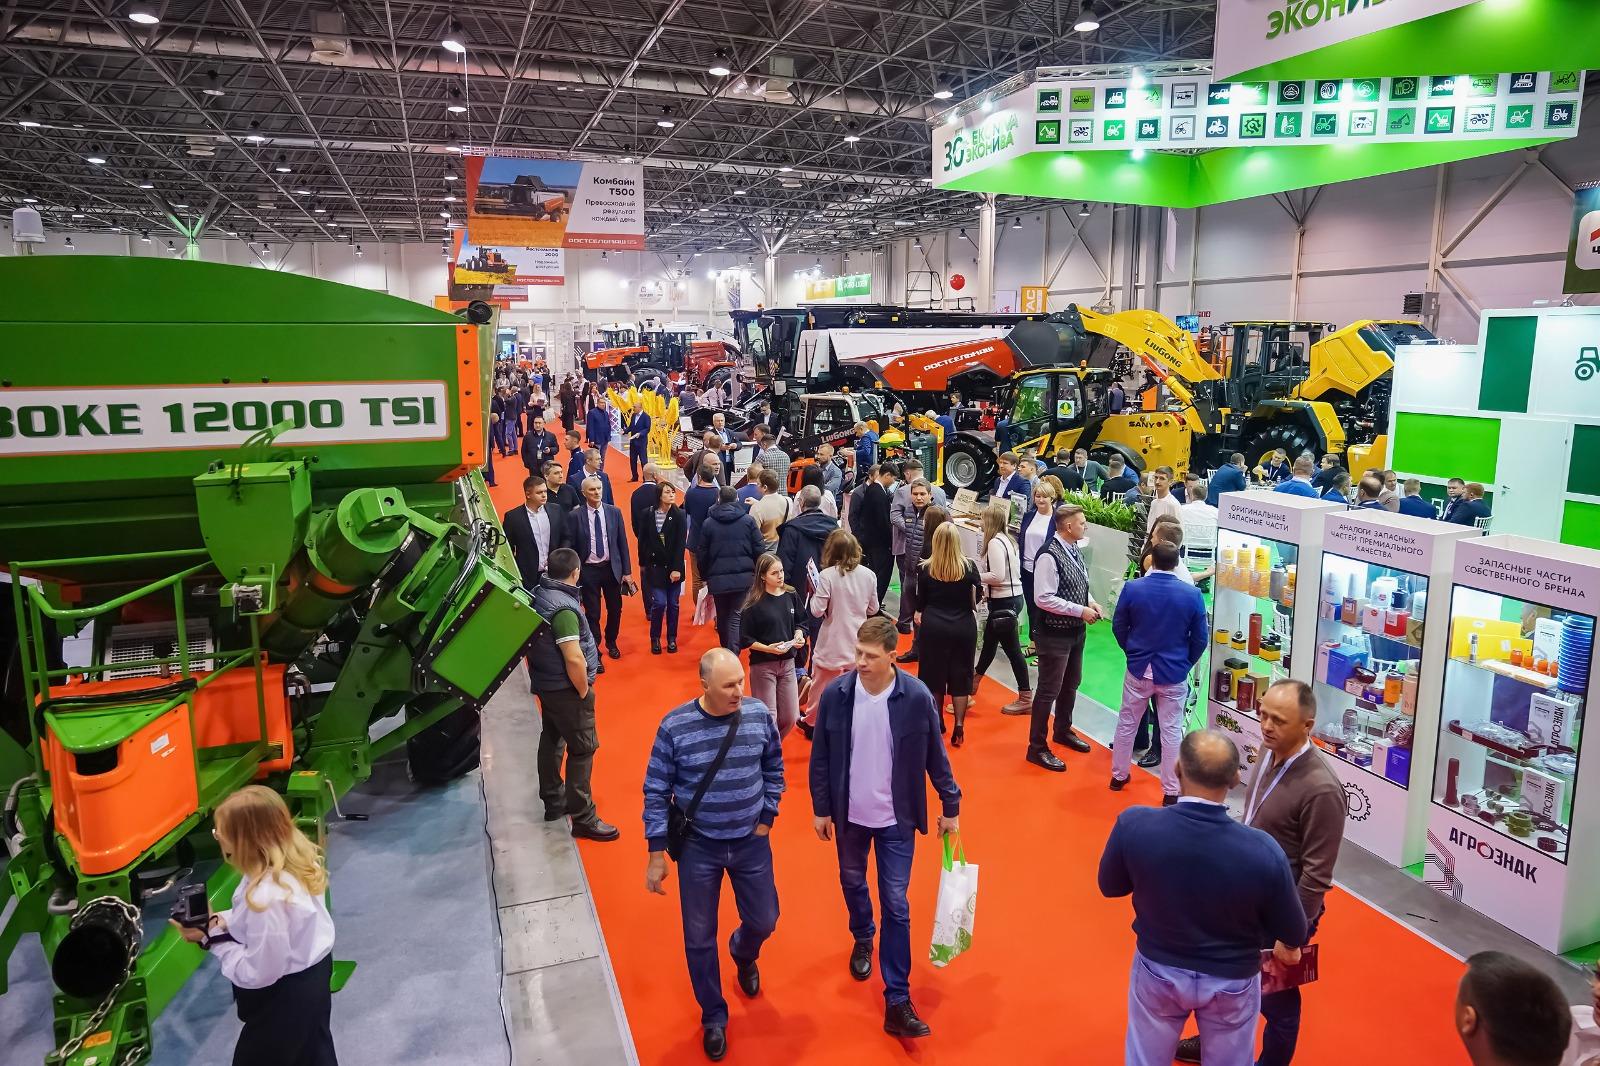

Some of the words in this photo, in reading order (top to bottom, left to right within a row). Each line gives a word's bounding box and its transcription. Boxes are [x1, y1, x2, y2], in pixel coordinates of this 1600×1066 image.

[1265, 0, 1393, 40] ЭКОН
[966, 130, 1015, 163] ЭКОНИВА
[593, 176, 635, 186] Комбайн
[609, 187, 635, 196] Т500
[585, 198, 636, 207] Превосходный
[602, 208, 636, 216] результат
[162, 399, 345, 433] 12000
[360, 396, 438, 427] TSI
[1128, 421, 1155, 429] SANY
[1228, 513, 1263, 526] ЗАПАСНЫЕ
[1265, 521, 1289, 532] ЧАСТИ
[1231, 504, 1286, 522] ОРИГИНАЛЬНЫЕ
[1331, 530, 1357, 541] ЧАСТЕЙ
[1360, 536, 1424, 556] ПРЕМИАЛЬНОГО
[1339, 523, 1371, 536] АНАЛОГИ
[1374, 531, 1416, 545] ЗАПАСНЫХ
[1356, 545, 1393, 559] КАЧЕСТВА
[1479, 557, 1532, 576] ЗАПАСНЫЕ
[1536, 569, 1572, 584] ЧАСТИ
[1464, 564, 1540, 588] СОБСТВЕННОГО
[1544, 582, 1586, 599] БРЕНДА
[1449, 826, 1538, 884] АГРОЗНАК
